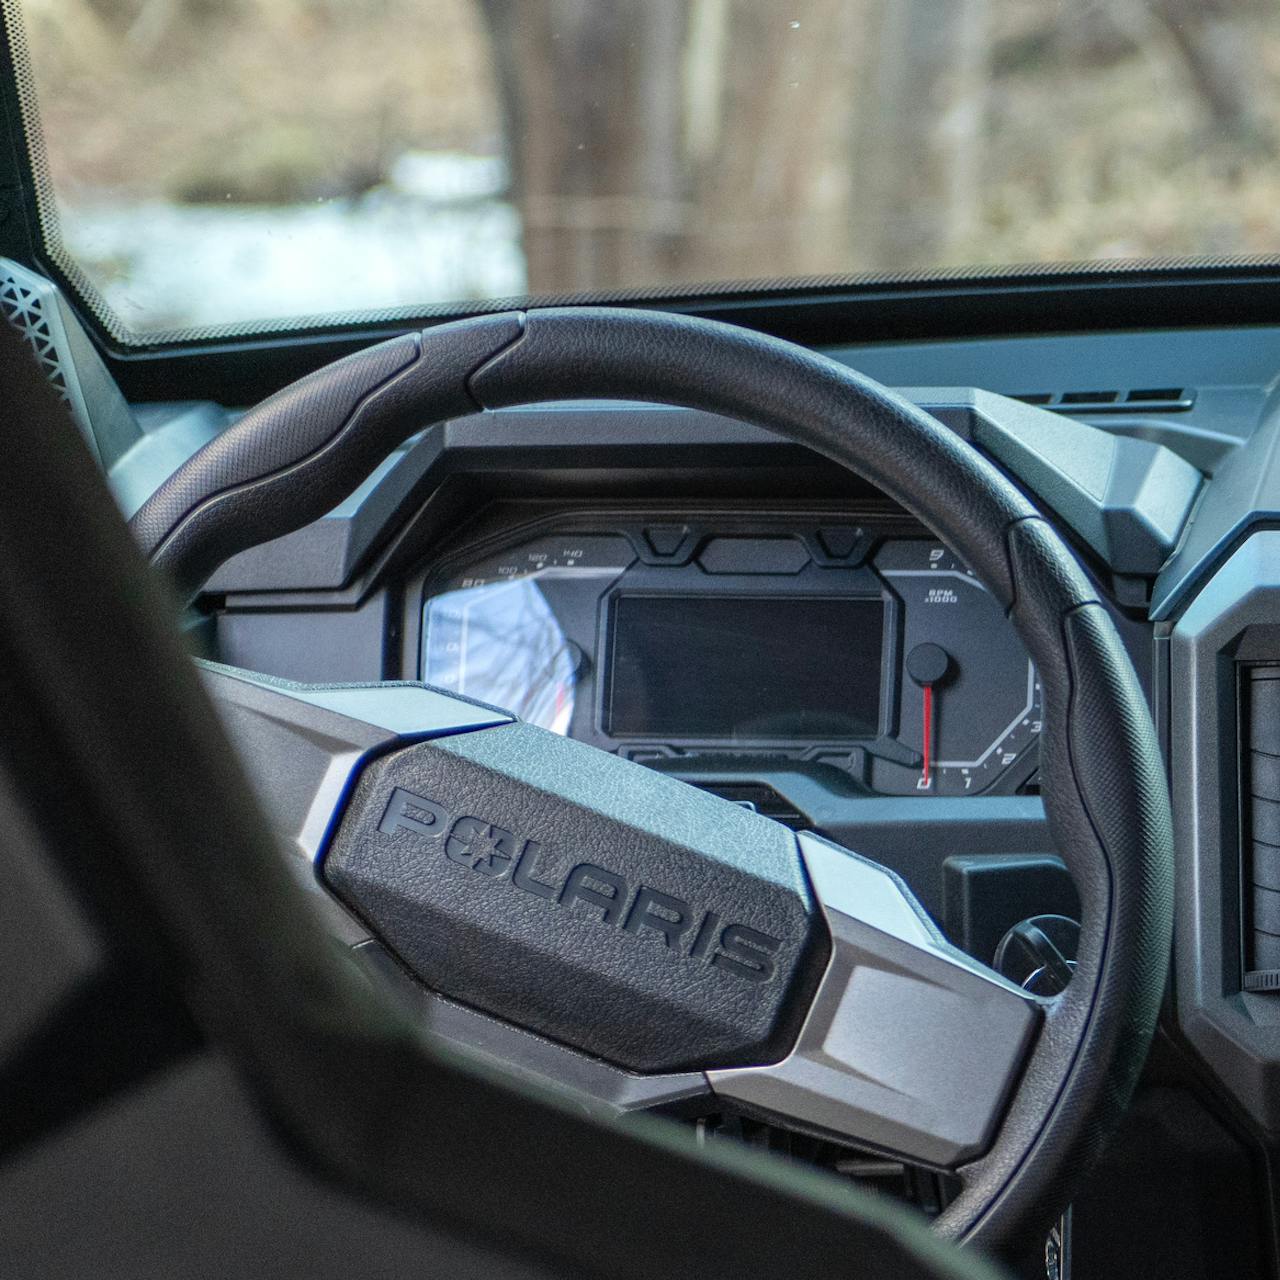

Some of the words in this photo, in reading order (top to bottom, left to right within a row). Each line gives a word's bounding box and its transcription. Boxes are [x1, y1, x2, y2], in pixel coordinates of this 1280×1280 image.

[929, 549, 945, 561] 9
[928, 589, 953, 597] RPM
[1030, 721, 1042, 733] 3
[1001, 753, 1017, 765] 2
[964, 777, 972, 789] 1
[376, 786, 786, 984] POLARIS
